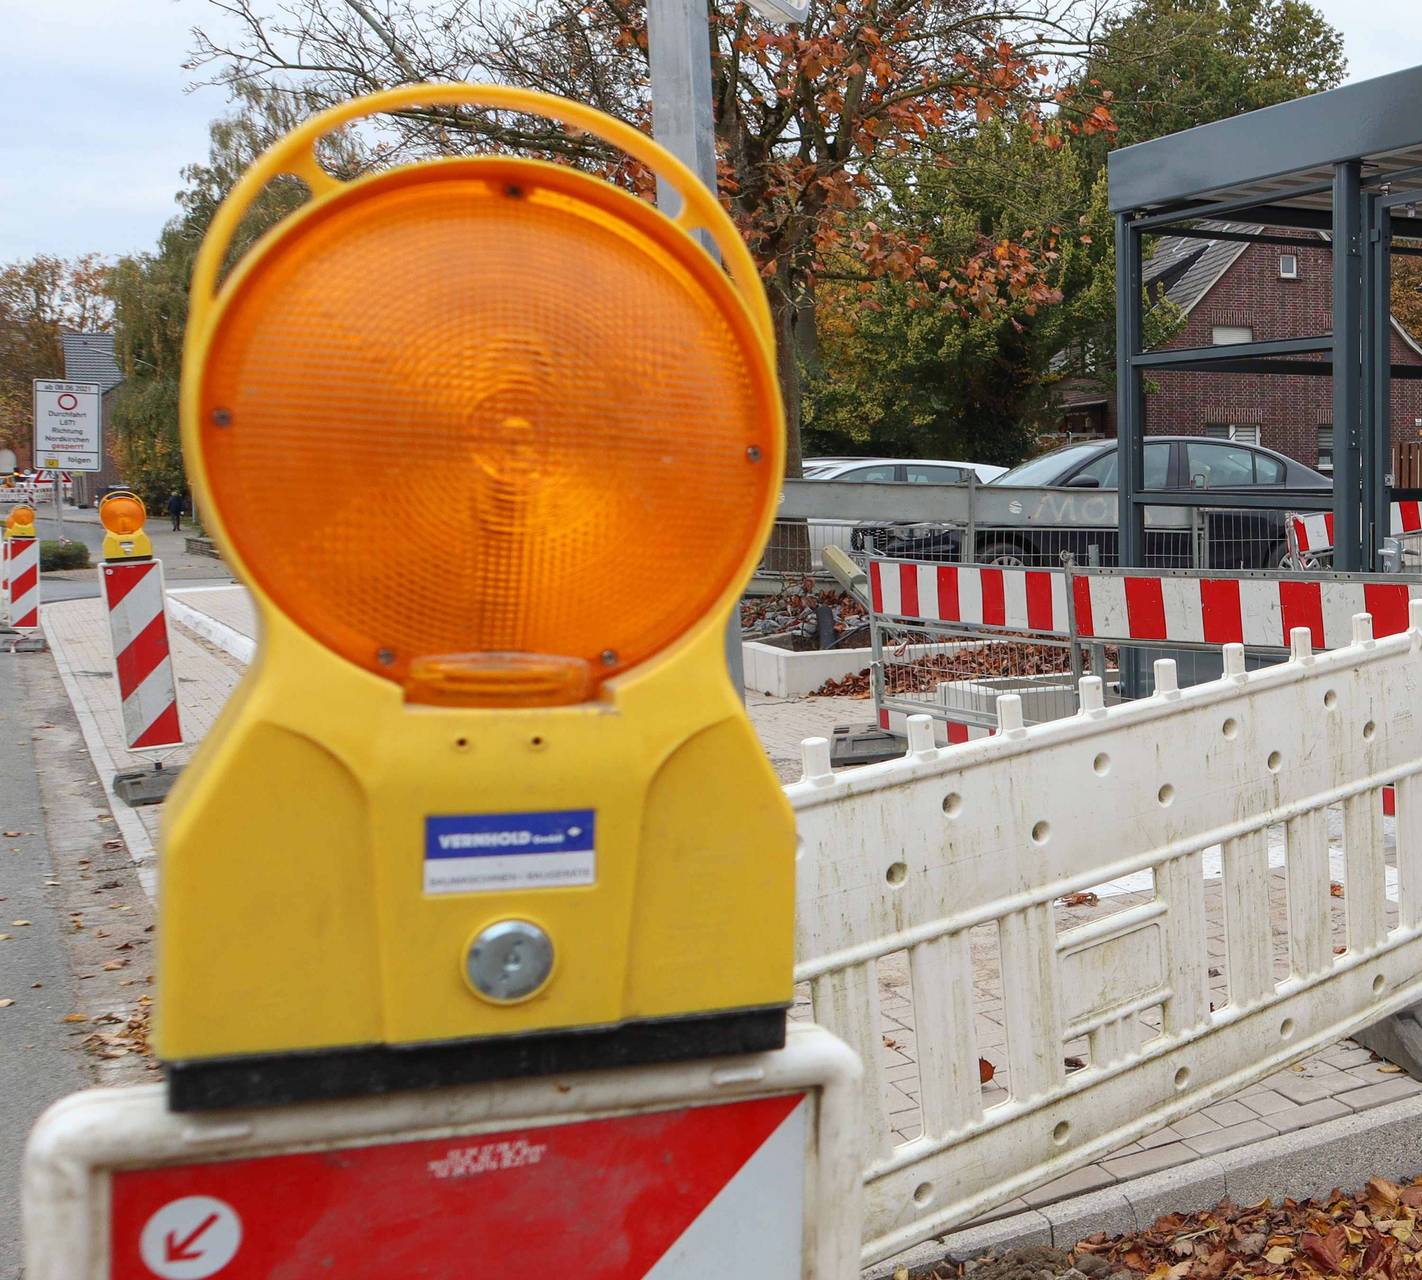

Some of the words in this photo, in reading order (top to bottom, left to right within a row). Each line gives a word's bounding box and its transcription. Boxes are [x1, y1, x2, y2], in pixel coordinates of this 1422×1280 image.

[48, 410, 87, 418] Durchfahrt
[51, 427, 83, 435] Richtung
[45, 435, 90, 443] Nordkirchen
[68, 456, 91, 464] folgen
